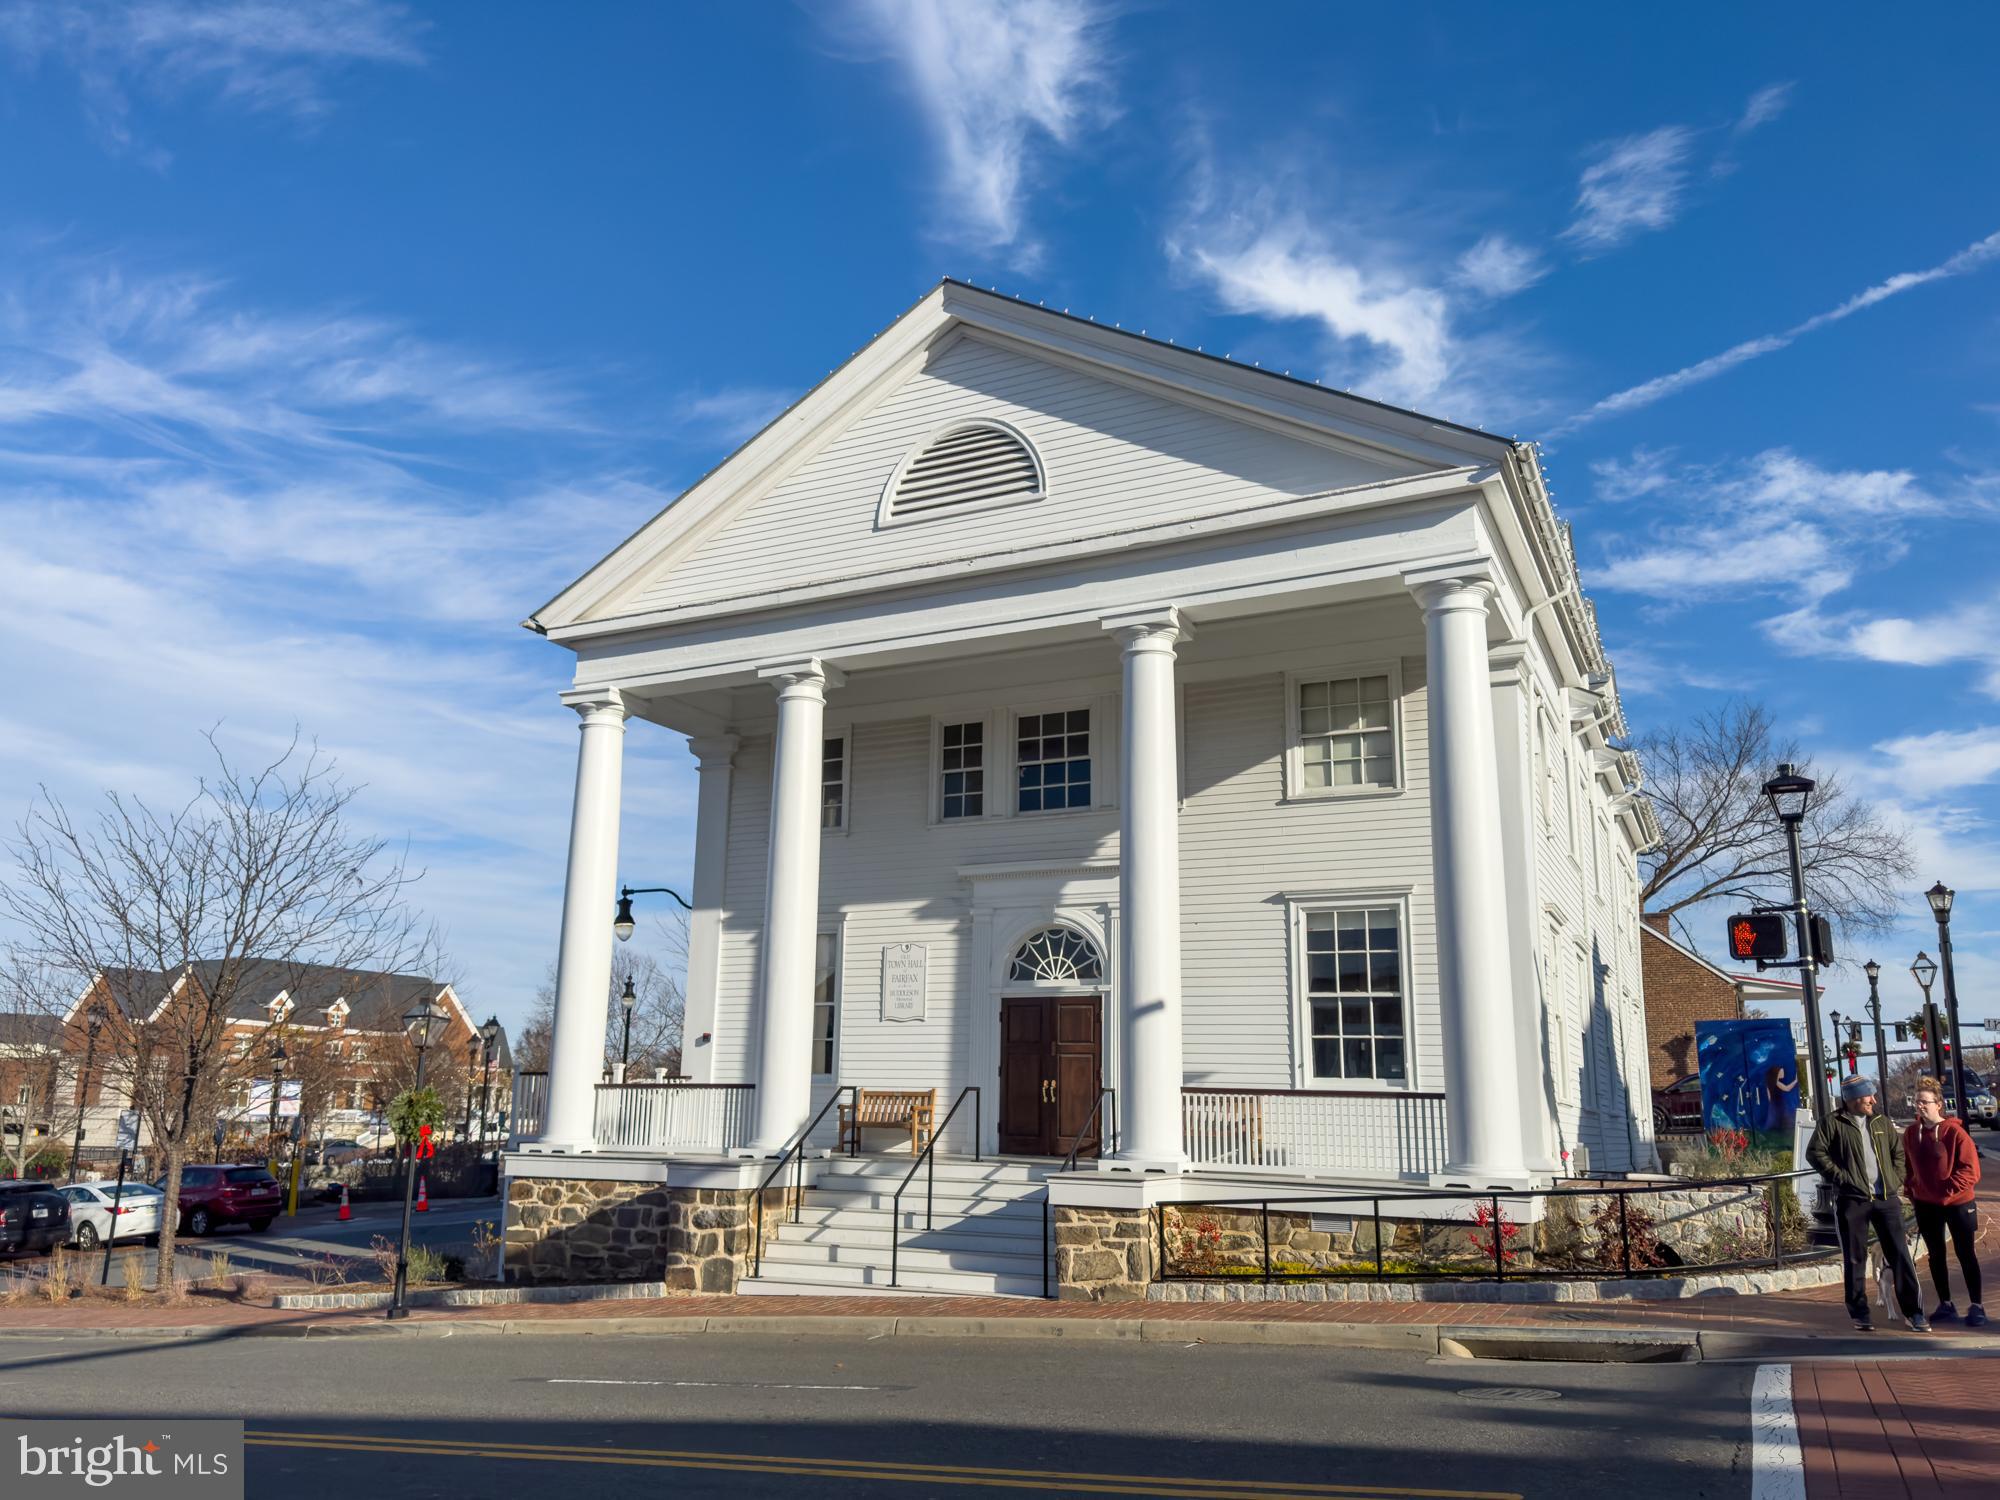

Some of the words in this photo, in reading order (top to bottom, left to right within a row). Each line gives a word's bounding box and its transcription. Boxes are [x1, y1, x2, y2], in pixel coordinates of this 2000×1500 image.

[888, 960, 906, 969] TOWN
[908, 959, 924, 968] HALL
[891, 973, 919, 983] FAIRFAX
